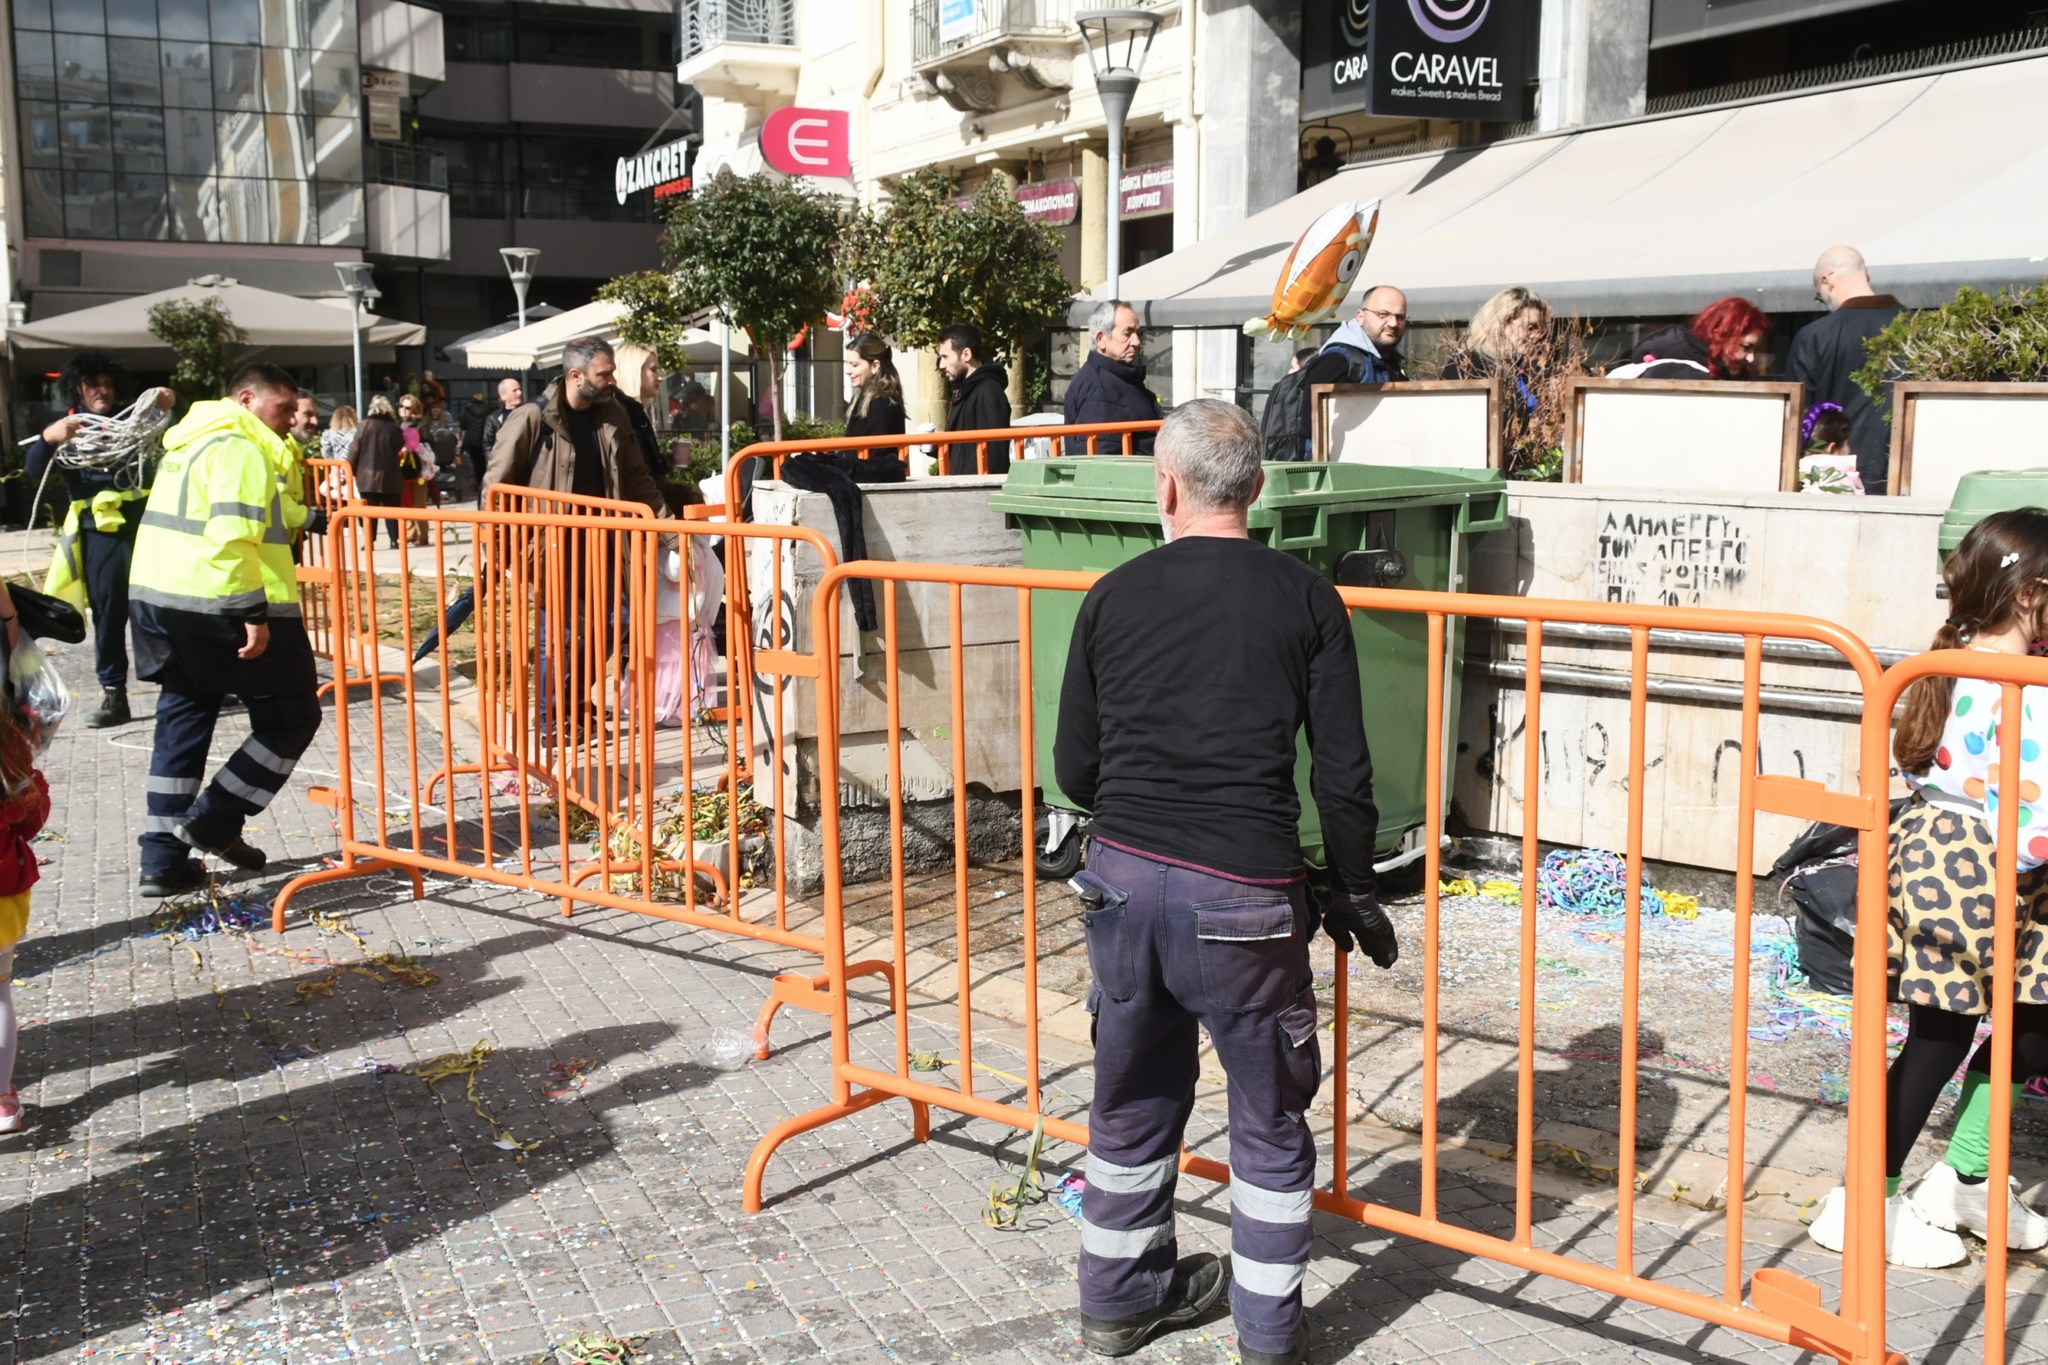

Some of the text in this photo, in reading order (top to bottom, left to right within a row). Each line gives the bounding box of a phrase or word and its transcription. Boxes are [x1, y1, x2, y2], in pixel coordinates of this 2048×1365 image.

[1391, 52, 1503, 87] CARAVEL
[1391, 86, 1416, 97] makes
[1417, 86, 1445, 99] Sweets
[1452, 88, 1477, 100] makes
[1478, 90, 1502, 101] Bread
